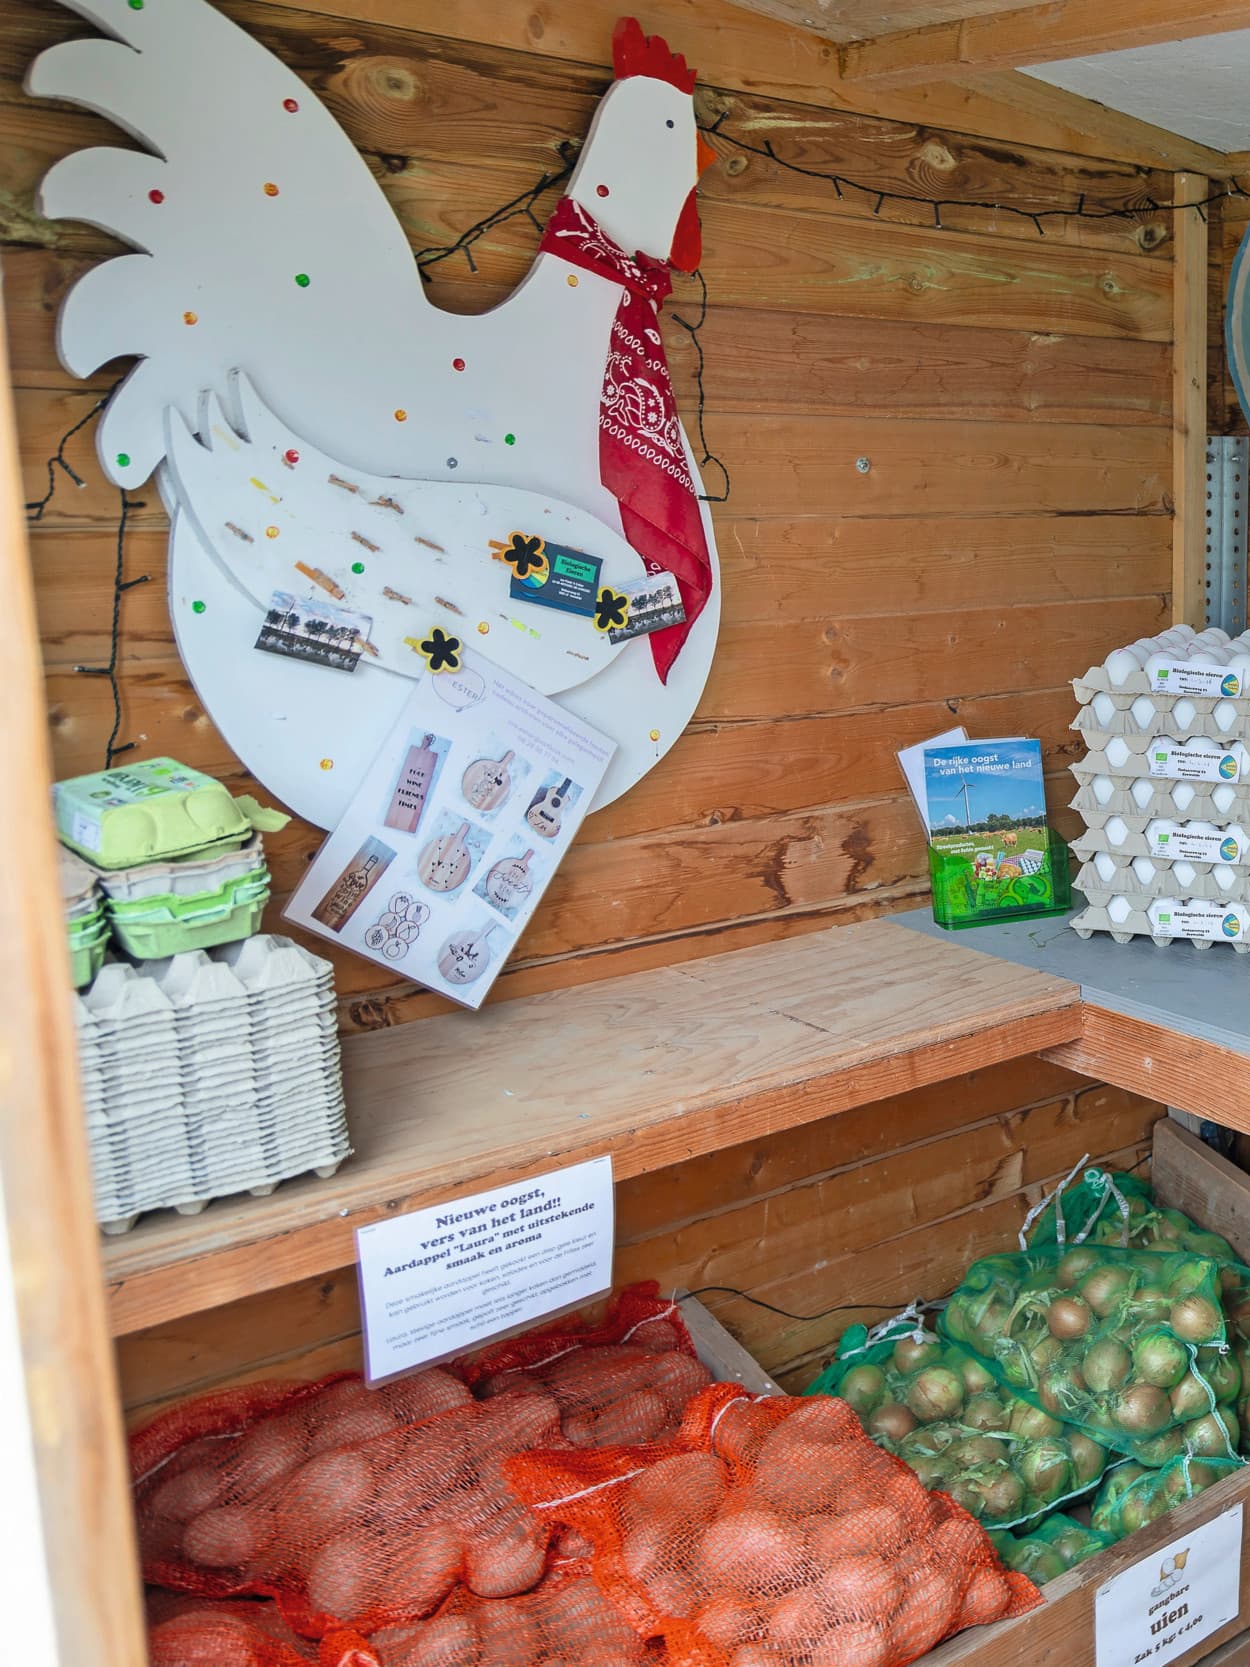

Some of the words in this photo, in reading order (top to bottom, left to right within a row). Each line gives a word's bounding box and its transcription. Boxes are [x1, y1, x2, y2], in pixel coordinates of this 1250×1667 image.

[934, 759, 945, 767] De
[949, 757, 968, 766] rijke
[971, 754, 998, 764] oogst
[977, 764, 1009, 772] nieuwe
[1012, 760, 1032, 769] land
[420, 1232, 454, 1250] vers
[460, 1222, 488, 1240] van
[491, 1211, 516, 1229] het
[520, 1197, 561, 1220] land!!
[436, 1202, 497, 1229] Nieuwe
[500, 1188, 545, 1212] oogst,
[384, 1248, 451, 1277] Aardappel
[453, 1232, 500, 1253] "Laura"
[502, 1225, 525, 1238] met
[528, 1201, 595, 1229] uitstekende
[445, 1252, 485, 1271] smaak
[489, 1247, 502, 1255] en
[505, 1232, 542, 1250] aroma
[1151, 1603, 1189, 1635] uien
[1135, 1649, 1152, 1664] Zak
